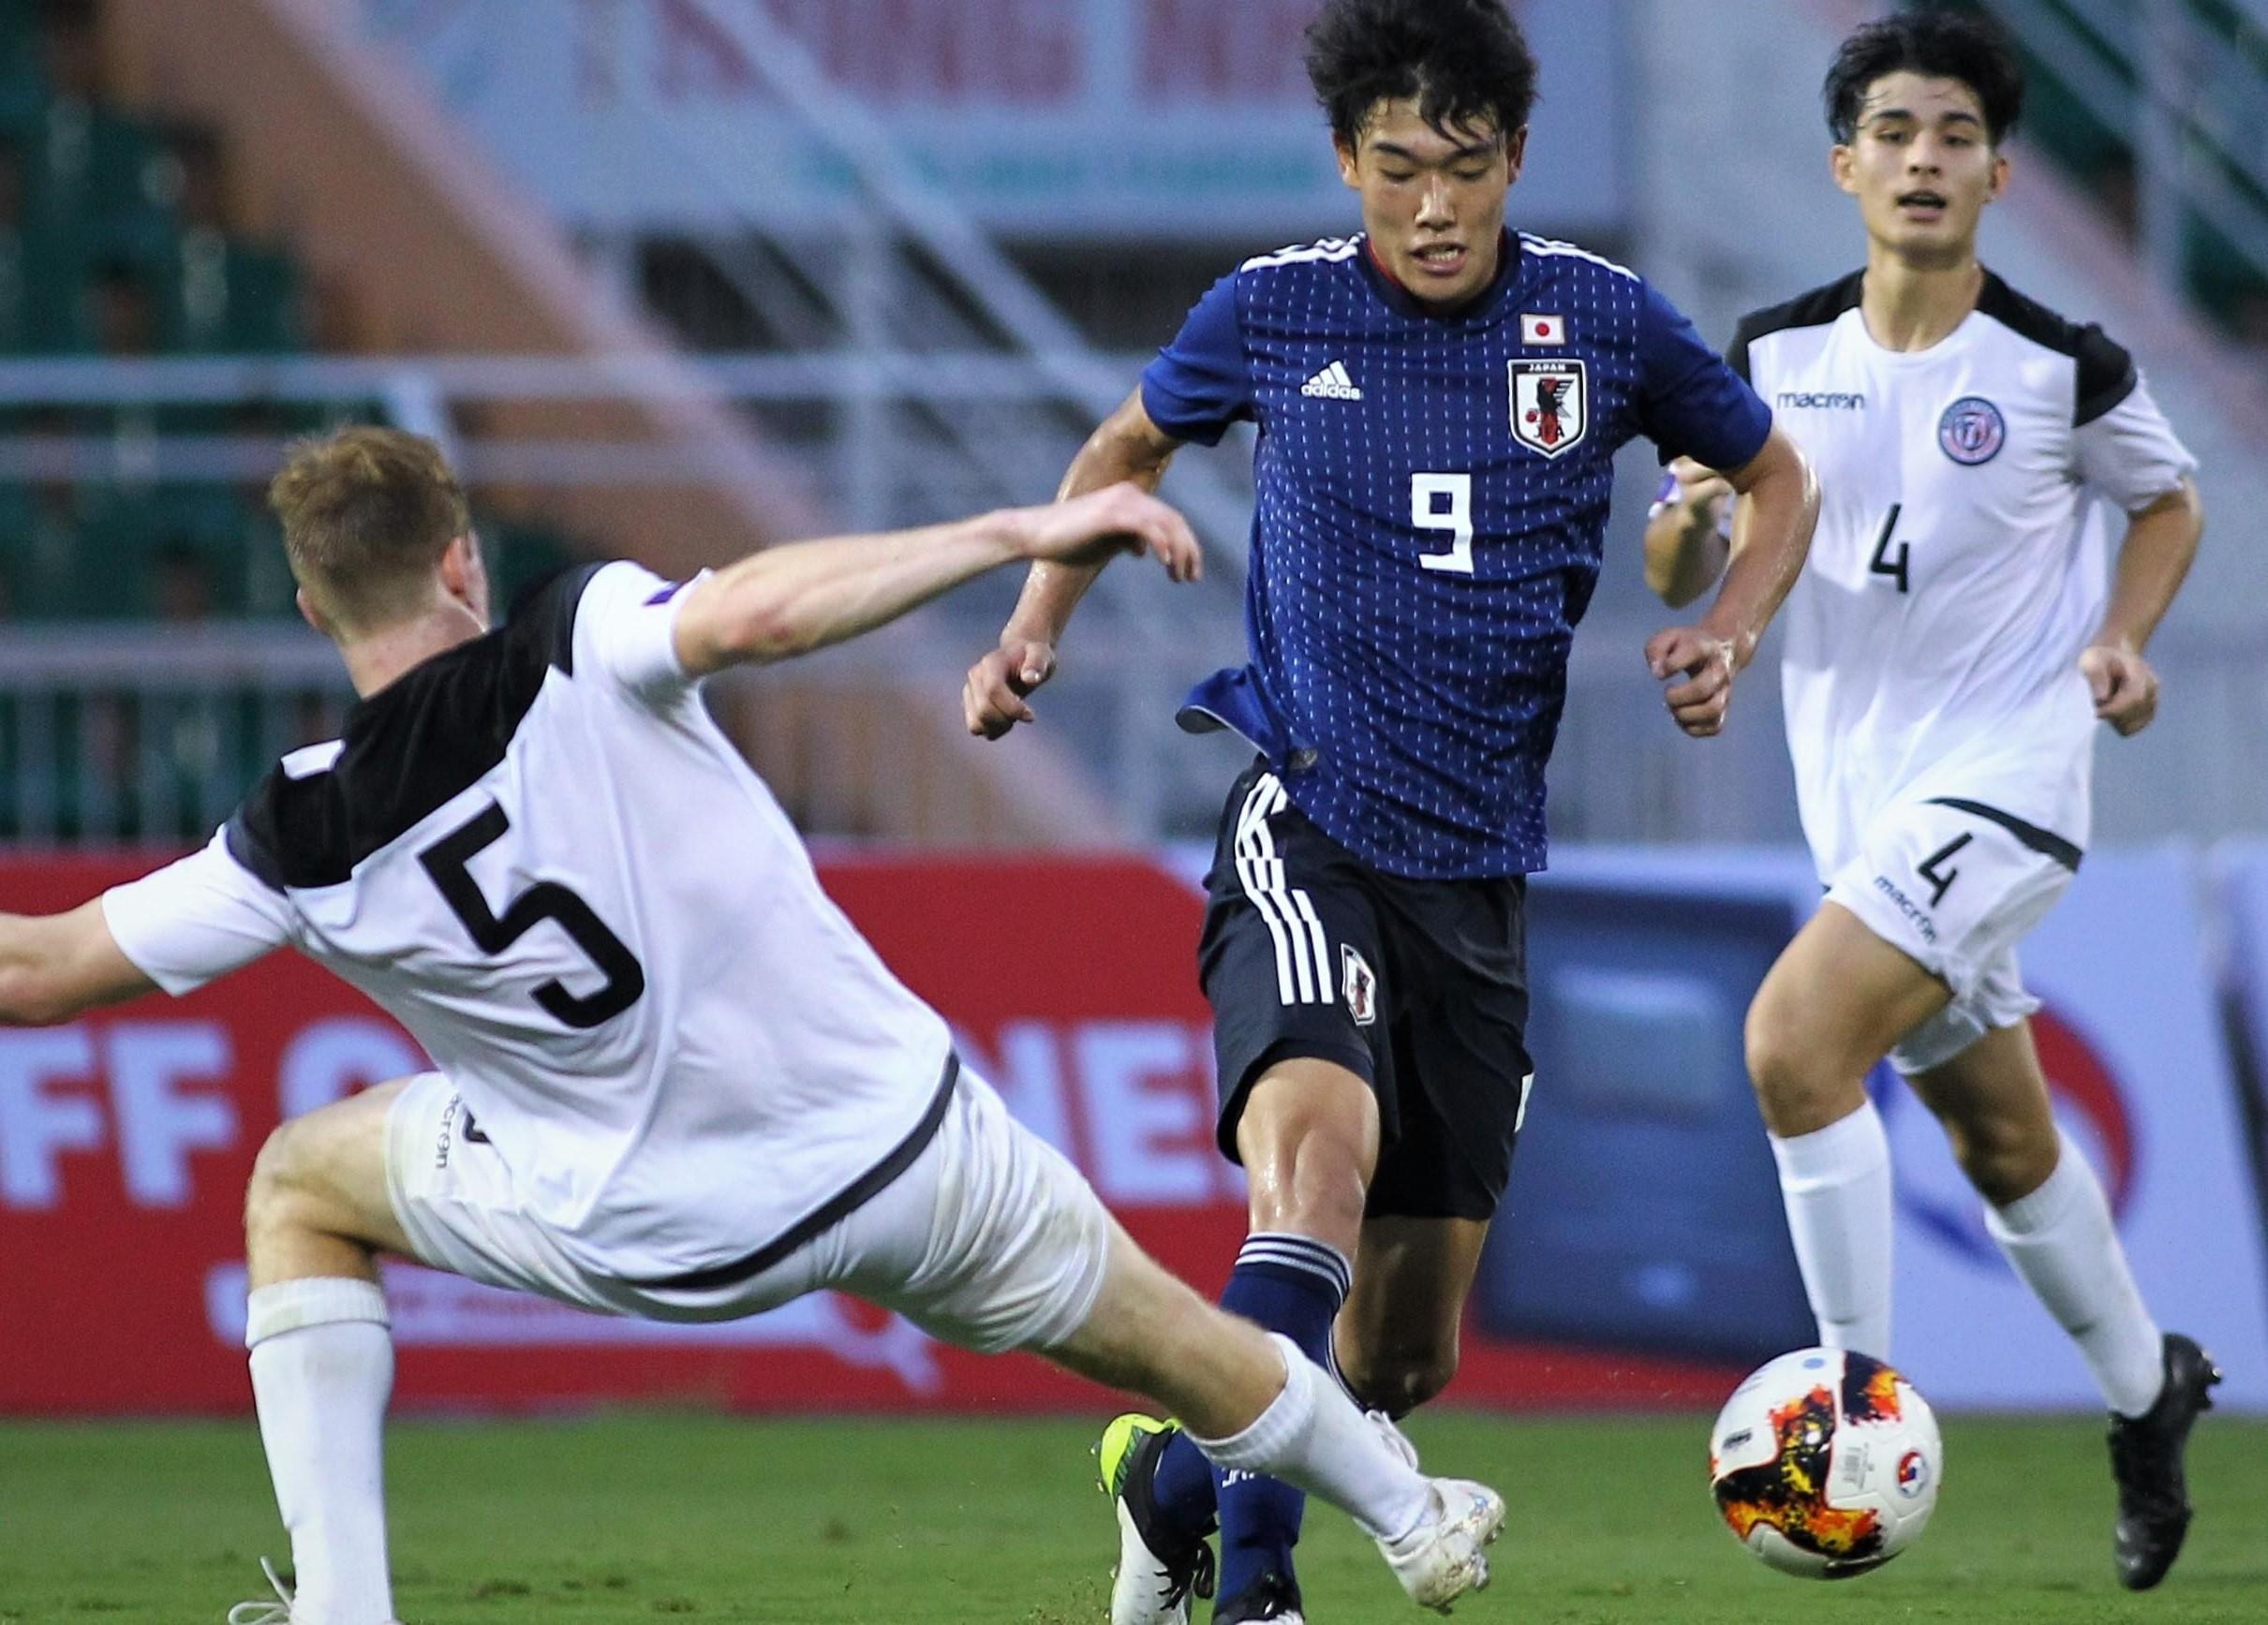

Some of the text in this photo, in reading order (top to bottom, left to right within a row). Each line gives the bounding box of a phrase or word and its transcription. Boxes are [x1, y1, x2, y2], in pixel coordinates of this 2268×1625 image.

[1300, 383, 1361, 401] adidas
[1529, 362, 1566, 372] JAPAN
[1776, 391, 1864, 409] macron
[1411, 472, 1474, 573] 9
[1870, 503, 1909, 592] 4
[1918, 831, 1973, 909] 4
[416, 798, 645, 1028] 5
